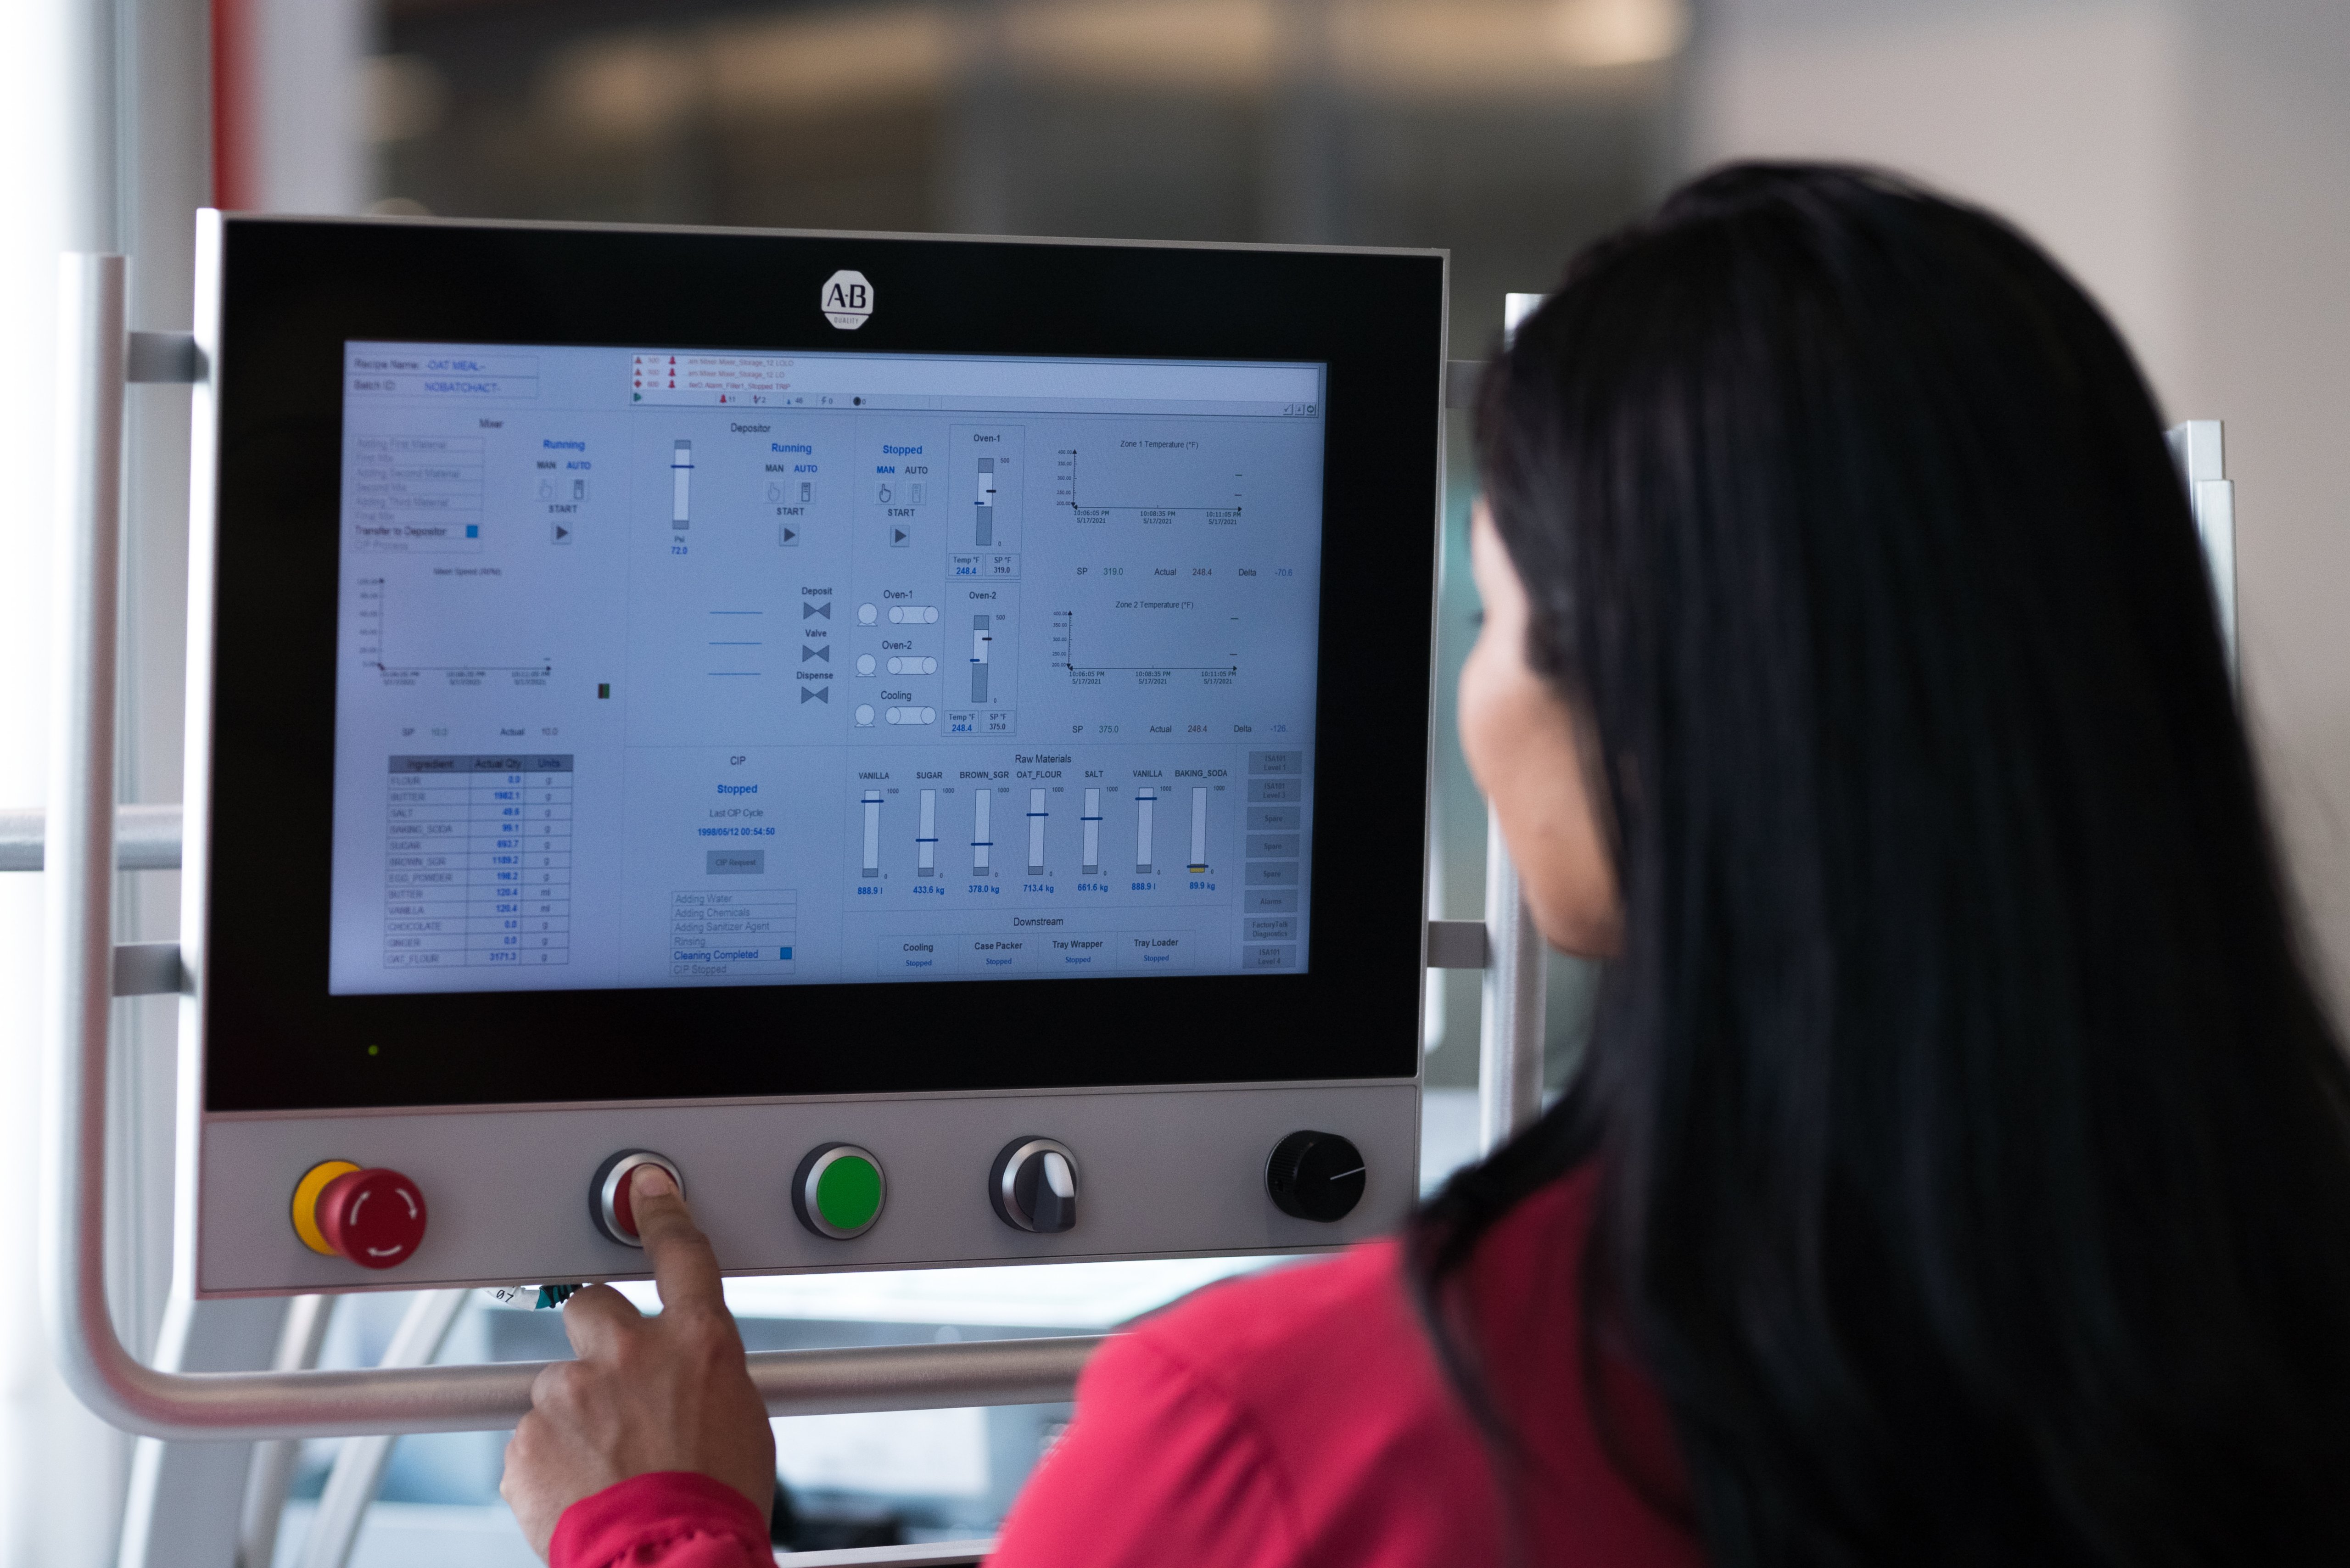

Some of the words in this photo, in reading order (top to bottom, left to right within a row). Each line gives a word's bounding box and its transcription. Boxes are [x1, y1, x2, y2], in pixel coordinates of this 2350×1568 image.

[479, 417, 505, 429] Mixer
[730, 423, 771, 434] Depositor
[974, 434, 1001, 442] Oven-1
[543, 438, 586, 452] Running
[772, 443, 812, 455] Running
[1144, 440, 1185, 449] Temperature
[883, 444, 923, 457] Stopped
[537, 460, 557, 470] MAN
[566, 460, 592, 470] AUTO
[765, 464, 784, 473] MAN
[794, 465, 818, 473] AUTO
[905, 466, 928, 474] AUTO
[548, 504, 577, 513] START
[777, 507, 805, 515] START
[887, 508, 915, 516] START
[671, 546, 688, 555] 72.0
[953, 556, 972, 565] Temp
[1239, 568, 1257, 577] Delta
[801, 587, 833, 596] Deposit
[883, 590, 913, 599] Oven-1
[1140, 601, 1180, 610] Temperature
[805, 629, 827, 637] Valve
[882, 640, 912, 650] Oven-2
[796, 671, 834, 681] Dispense
[880, 691, 912, 701] Cooling
[949, 713, 967, 722] Temp
[1233, 725, 1252, 733] Delta
[730, 756, 746, 766] CIP
[1015, 754, 1034, 763] Raw
[1035, 754, 1072, 763] Materials
[407, 760, 454, 771] Ingredient
[474, 759, 503, 769] Actual
[506, 758, 521, 770] Qty
[538, 758, 561, 767] Units
[960, 771, 1009, 780] BROWN_SGR
[1016, 771, 1062, 780] OAT_FLOUR
[1175, 769, 1228, 778] BAKING_SODA
[717, 784, 757, 795] Stopped
[710, 809, 726, 818] Last
[727, 809, 741, 818] CIP
[743, 808, 764, 818] Cycle
[1265, 815, 1283, 823] Spare
[698, 828, 739, 836] 1998/05/12
[740, 827, 775, 836] 00:54:50
[1264, 843, 1282, 851] Spare
[729, 858, 756, 867] Request
[991, 885, 1000, 895] kg
[1046, 884, 1054, 893] kg
[1078, 883, 1097, 891] 661.6
[1100, 883, 1108, 892] kg
[1131, 882, 1151, 890] 888.9
[1207, 882, 1215, 891] kg
[857, 887, 878, 895] 888.9
[913, 886, 934, 894] 433.6
[936, 886, 945, 896] kg
[1013, 917, 1064, 927] Downstream
[1252, 921, 1288, 929] FactoryTalk
[903, 942, 934, 953] Cooling
[974, 941, 994, 951] Case
[996, 941, 1023, 951] Packer
[1052, 940, 1069, 950] Tray
[1070, 940, 1103, 950] Wrapper
[1134, 939, 1150, 948] Tray
[1152, 938, 1179, 947] Loader
[673, 950, 711, 962] Cleaning
[713, 949, 758, 962] Completed
[1065, 956, 1091, 964] Stopped
[1144, 954, 1169, 963] Stopped
[906, 959, 932, 968] Stopped
[985, 957, 1012, 966] Stopped
